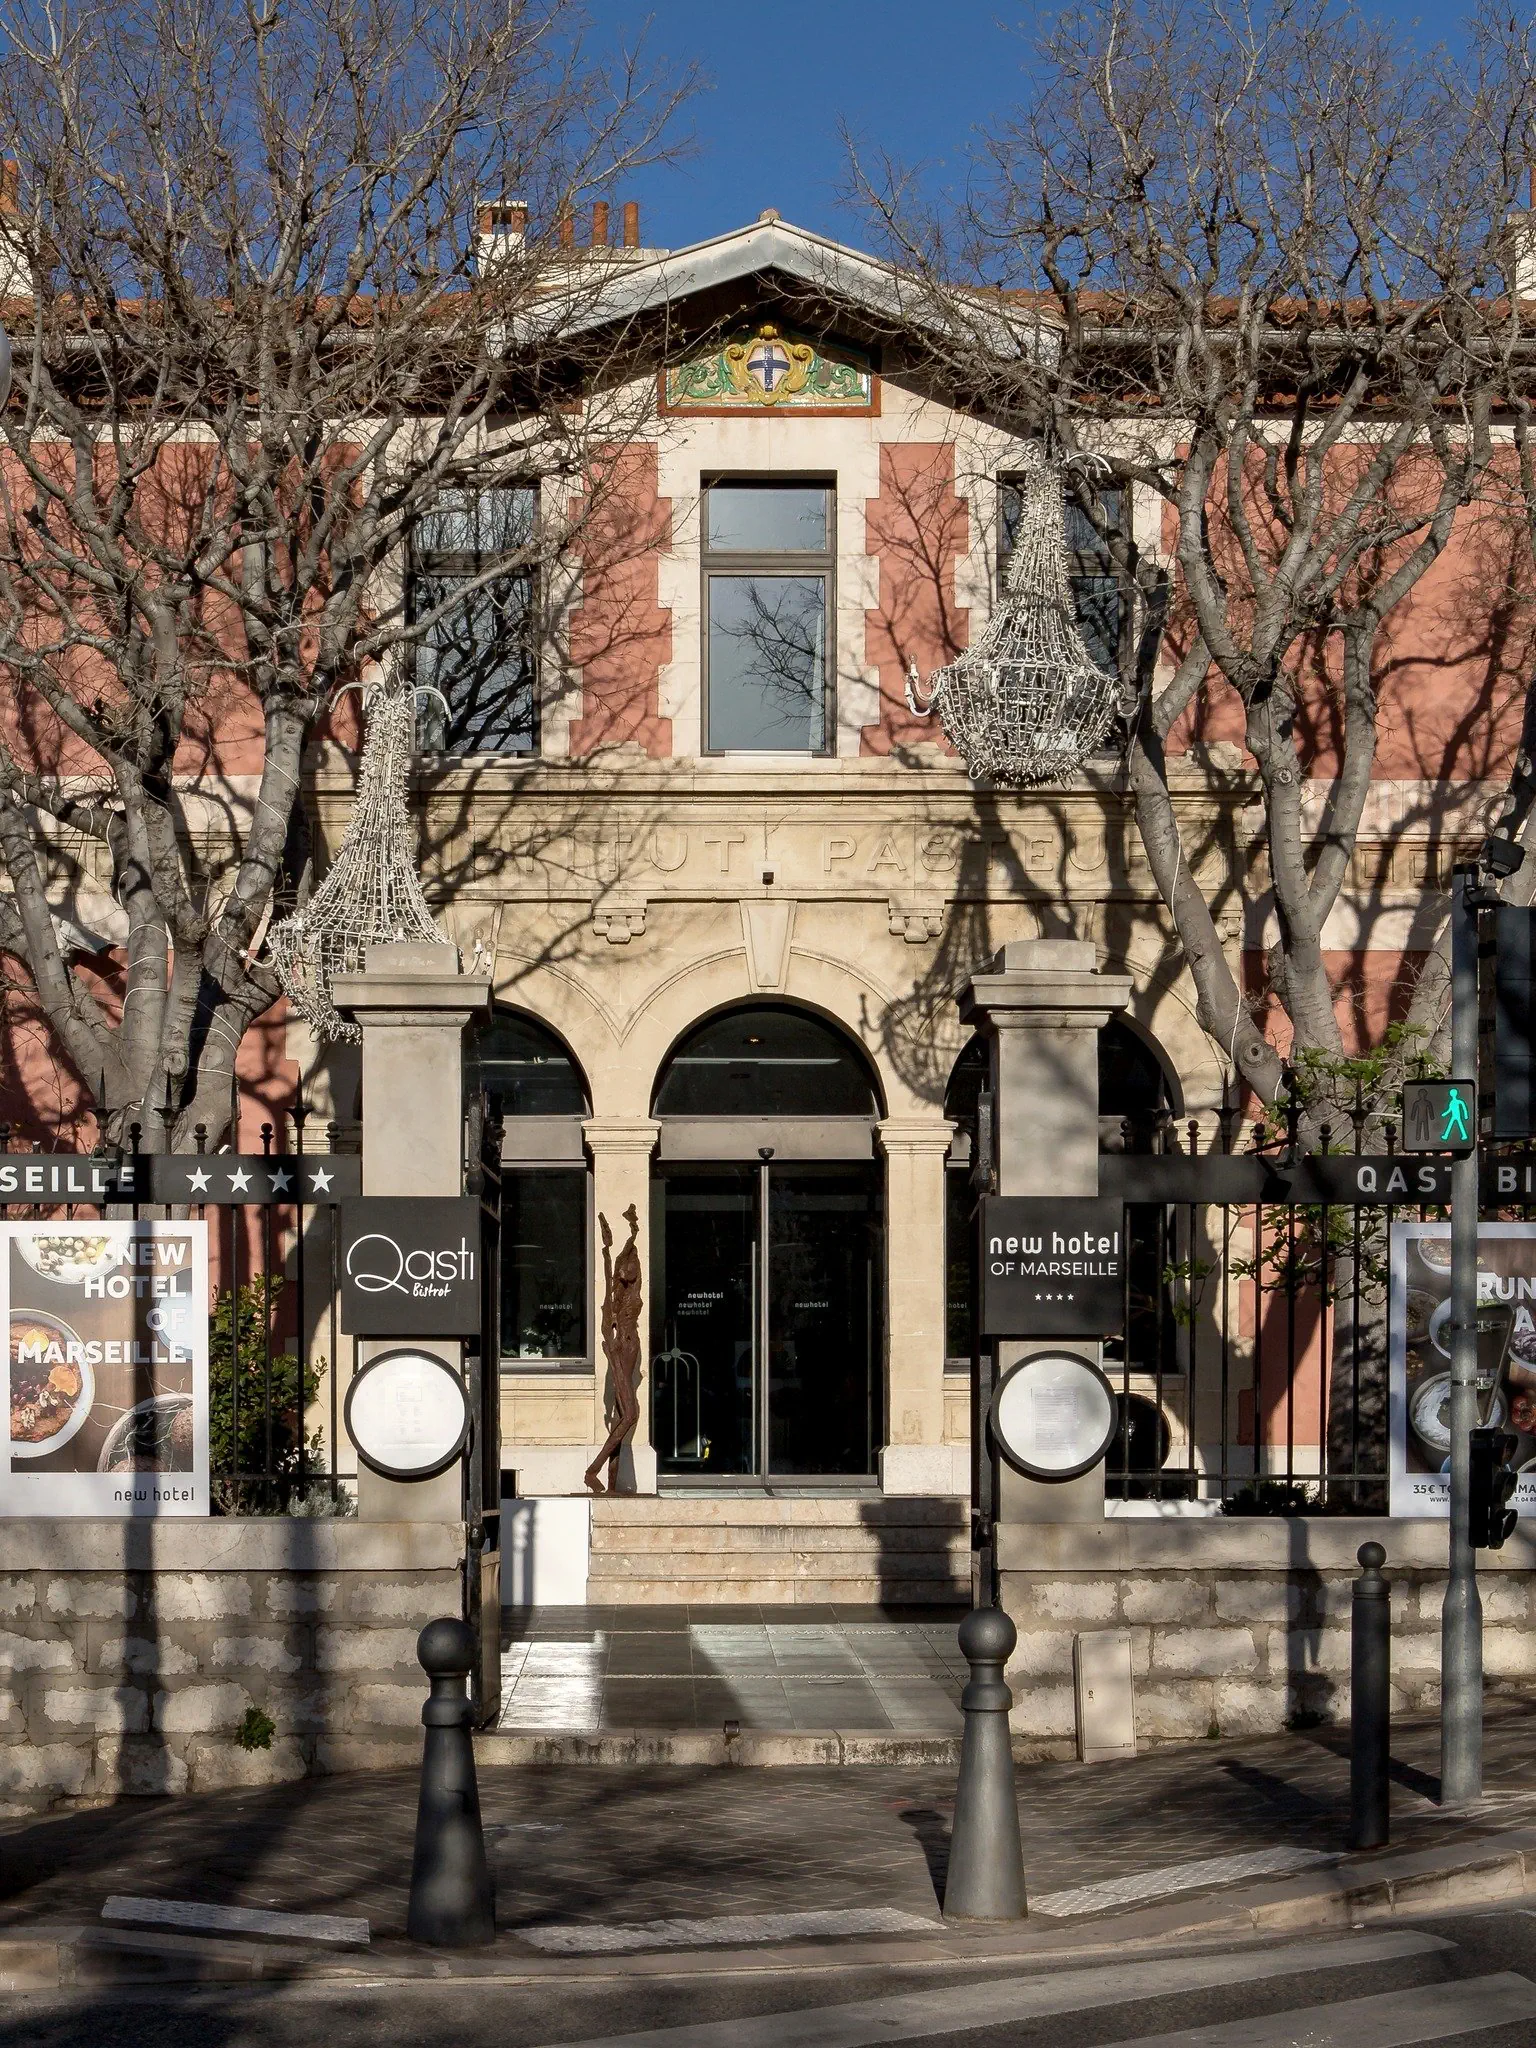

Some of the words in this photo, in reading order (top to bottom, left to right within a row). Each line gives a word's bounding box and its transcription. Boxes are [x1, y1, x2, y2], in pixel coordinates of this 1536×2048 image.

[418, 833, 746, 873] NSTITUT
[823, 834, 1154, 873] PASTEUR
[0, 1165, 135, 1193] SEILLE
[1357, 1165, 1452, 1193] QAS
[1498, 1166, 1532, 1193] BI
[116, 1242, 187, 1266] NEW
[989, 1237, 1043, 1254] new
[1052, 1231, 1118, 1254] hotel
[346, 1233, 474, 1292] Qasti
[990, 1262, 1015, 1276] OF
[1020, 1262, 1118, 1276] MARSEILLE
[84, 1275, 187, 1299] HOTEL
[412, 1282, 452, 1297] Bistrot
[1477, 1276, 1536, 1300] RUN
[146, 1307, 187, 1332] OF
[17, 1340, 187, 1364] MARSEILLE
[114, 1490, 147, 1501] new
[153, 1487, 194, 1501] hotel
[1413, 1484, 1435, 1494] 35€
[1514, 1484, 1536, 1494] MA
